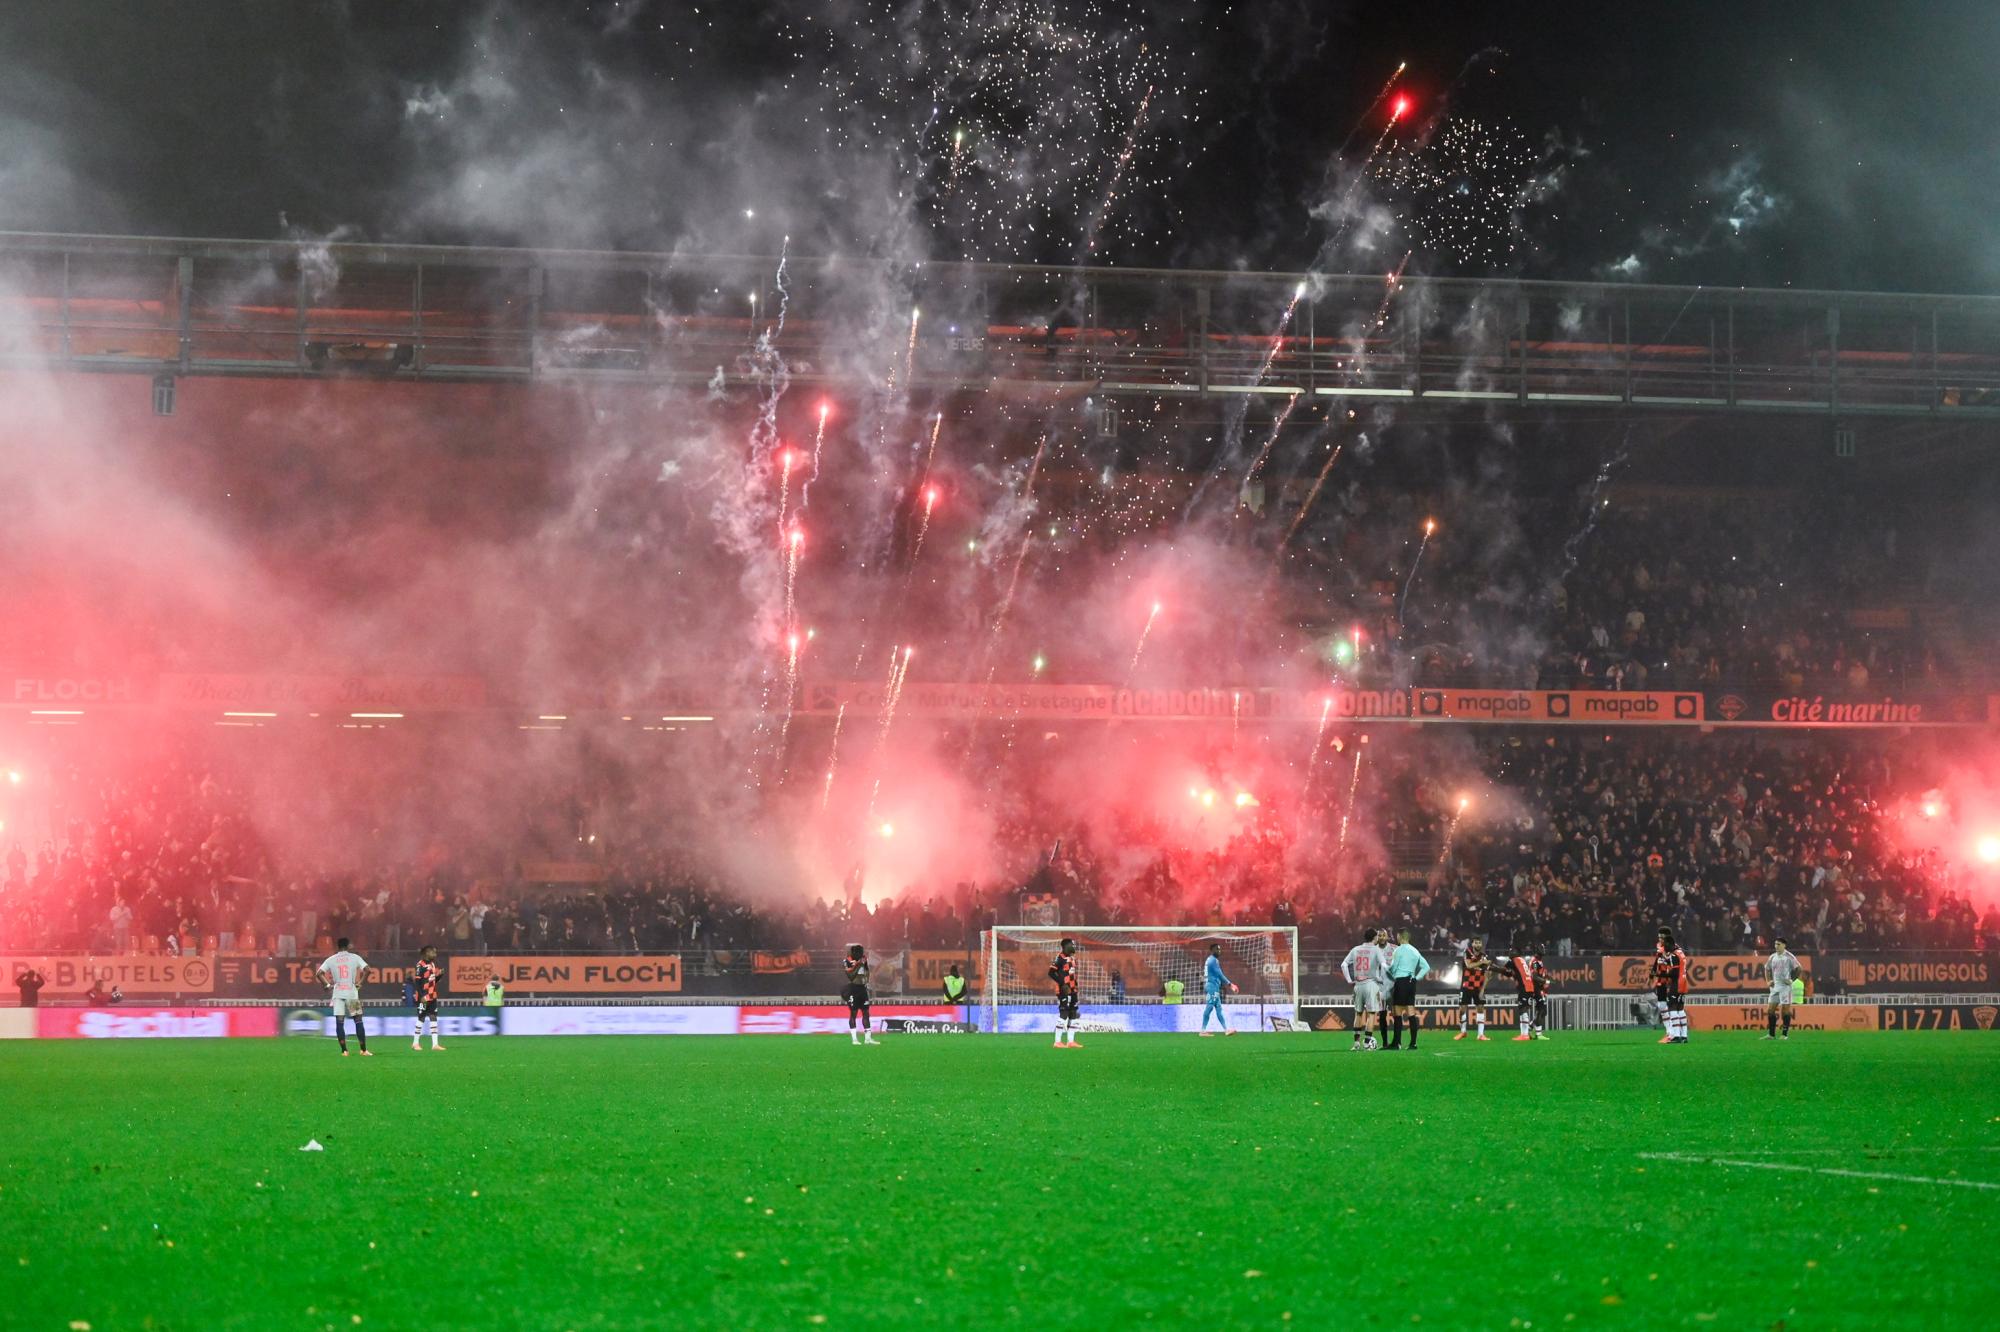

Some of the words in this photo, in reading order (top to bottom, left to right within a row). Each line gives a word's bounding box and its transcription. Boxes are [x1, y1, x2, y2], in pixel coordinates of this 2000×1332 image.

[1019, 693, 1107, 712] Bretagne
[1457, 694, 1532, 718] mapab
[1584, 694, 1659, 719] mapab
[1771, 696, 1823, 721] Cité
[1828, 697, 1922, 721] marine
[83, 965, 175, 983] HOTELS
[250, 963, 279, 984] Le
[336, 965, 350, 979] 16
[501, 962, 570, 983] JEAN
[584, 961, 676, 983] FLOC'H
[1355, 956, 1370, 971] 23
[1867, 963, 1988, 982] SPORTINGSOLS
[1884, 1009, 1962, 1031] PIZZA
